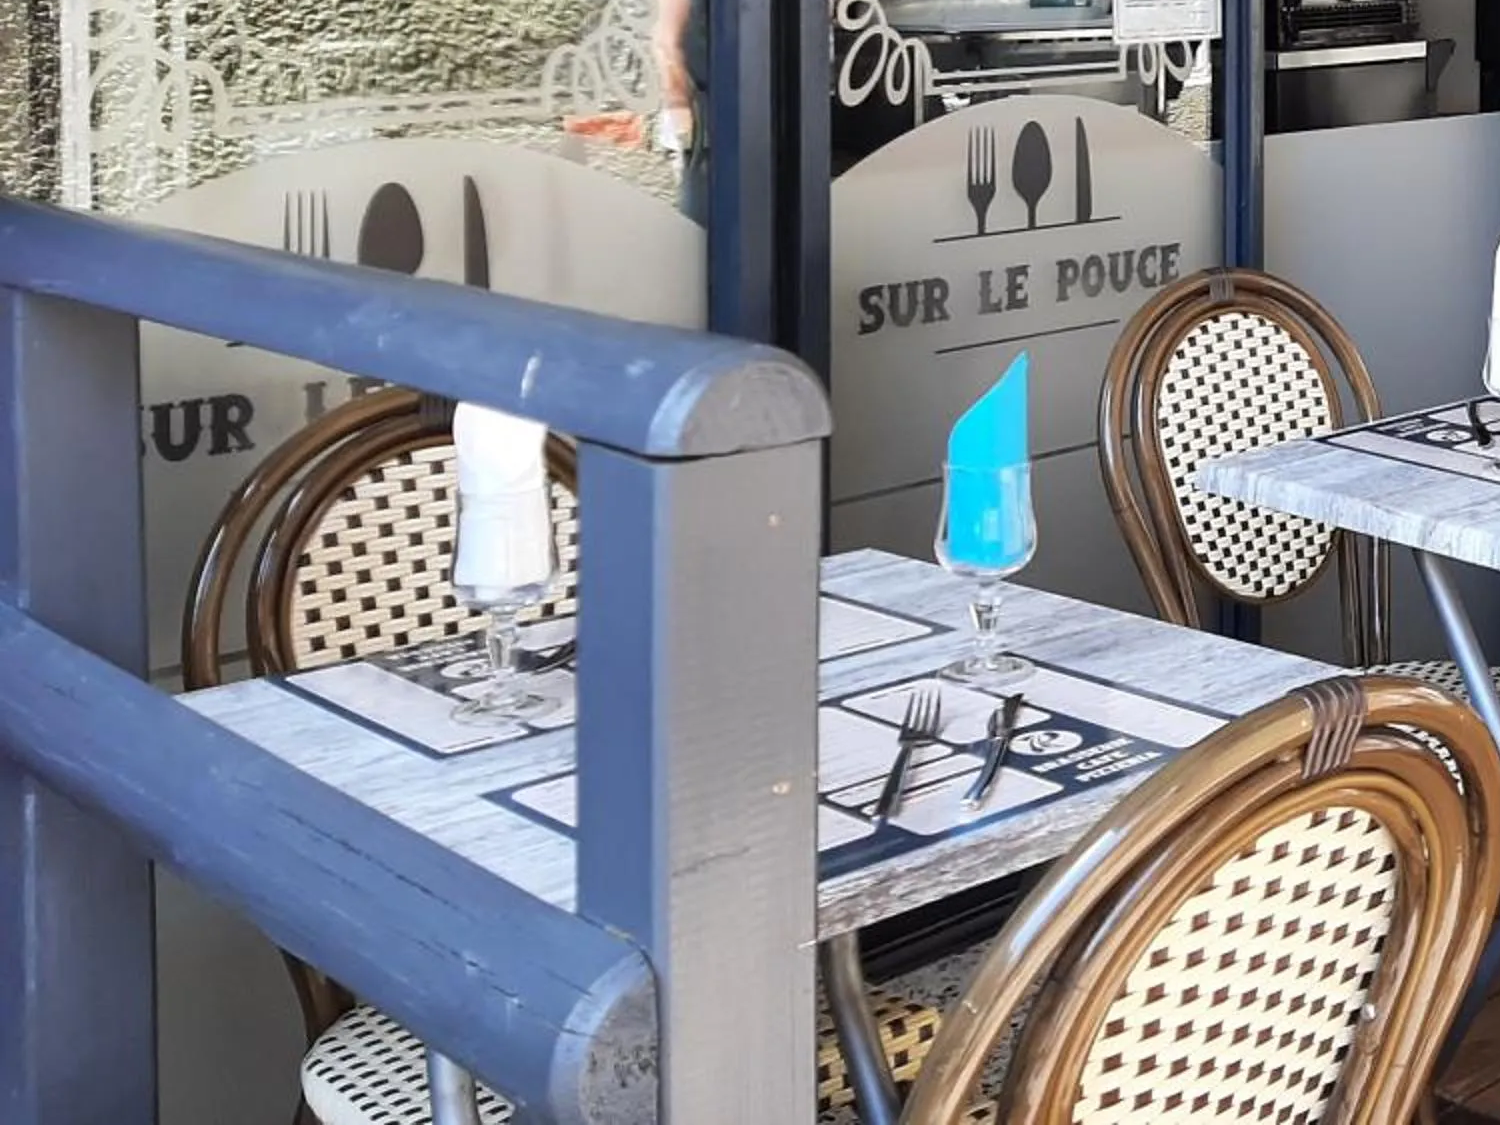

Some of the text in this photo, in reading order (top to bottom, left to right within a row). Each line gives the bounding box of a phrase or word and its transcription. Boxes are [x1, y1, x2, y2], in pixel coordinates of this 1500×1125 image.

[857, 242, 1182, 336] SUR LE POUCE
[138, 392, 256, 463] UR
